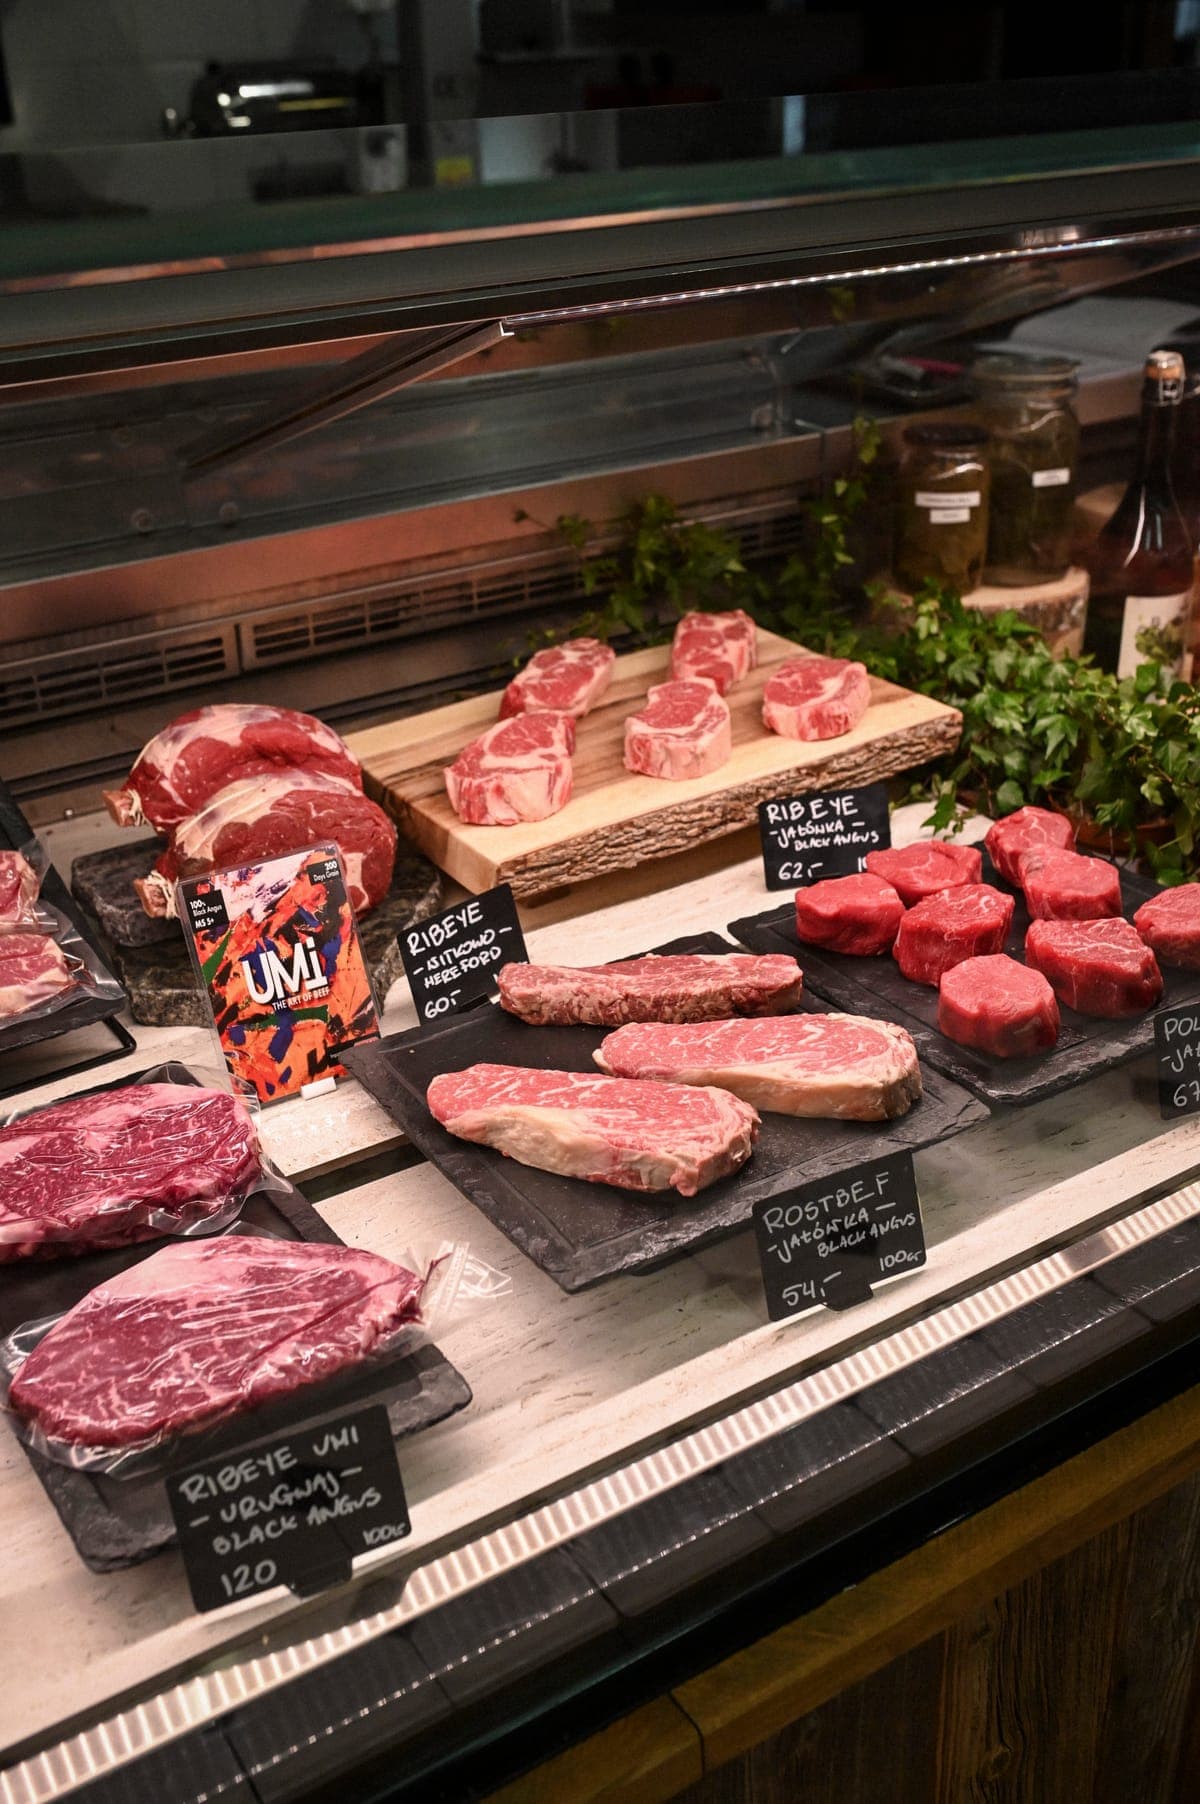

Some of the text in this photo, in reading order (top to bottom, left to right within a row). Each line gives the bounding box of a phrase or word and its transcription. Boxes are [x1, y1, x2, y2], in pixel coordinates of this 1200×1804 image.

[794, 830, 880, 851] BLACK ANGUS
[313, 873, 326, 882] Days
[324, 860, 337, 870] 200
[192, 907, 206, 917] Black
[195, 918, 206, 928] MS
[406, 901, 483, 956] RIBEYE
[424, 946, 502, 989] HEREFORD
[272, 986, 330, 1011] THE ART OF BEEF
[762, 1171, 889, 1234] ROSTBEF
[817, 1212, 916, 1257] BLACK ANGUS
[179, 1425, 359, 1503] RIBEYE UMI
[212, 1487, 382, 1555] BLACK ANGUS
[220, 1559, 277, 1596] 120
